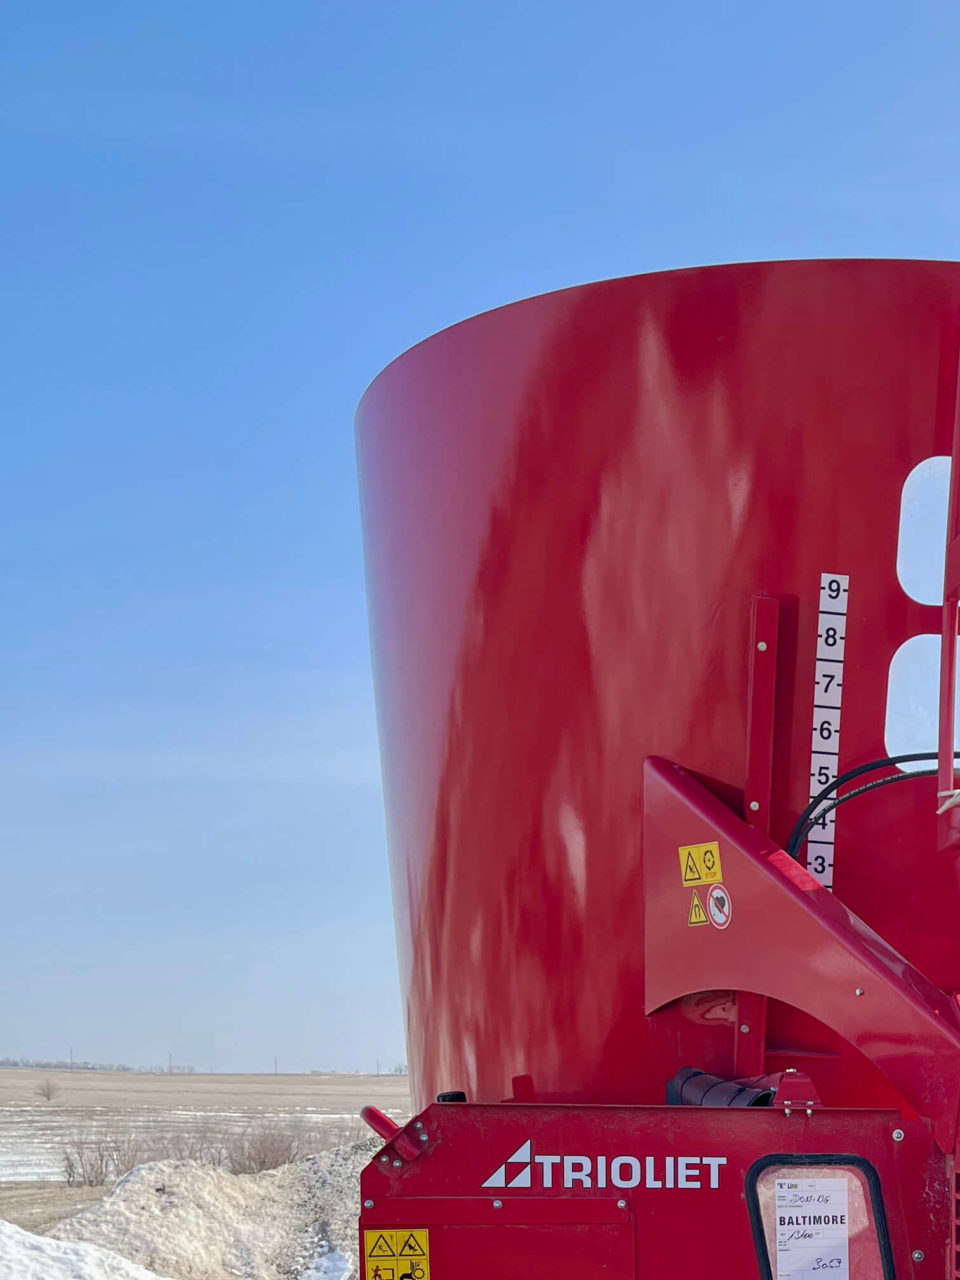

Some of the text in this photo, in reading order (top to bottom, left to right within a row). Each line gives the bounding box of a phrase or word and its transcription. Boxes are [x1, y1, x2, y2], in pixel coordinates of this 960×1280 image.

[828, 579, 841, 599] 9
[824, 627, 837, 647] 8
[821, 673, 836, 694] 7
[819, 720, 832, 740] 6
[817, 766, 830, 786] 5
[813, 855, 826, 875] 3
[534, 1155, 727, 1188] TRIOLIET
[779, 1214, 846, 1226] BALTIMORE
